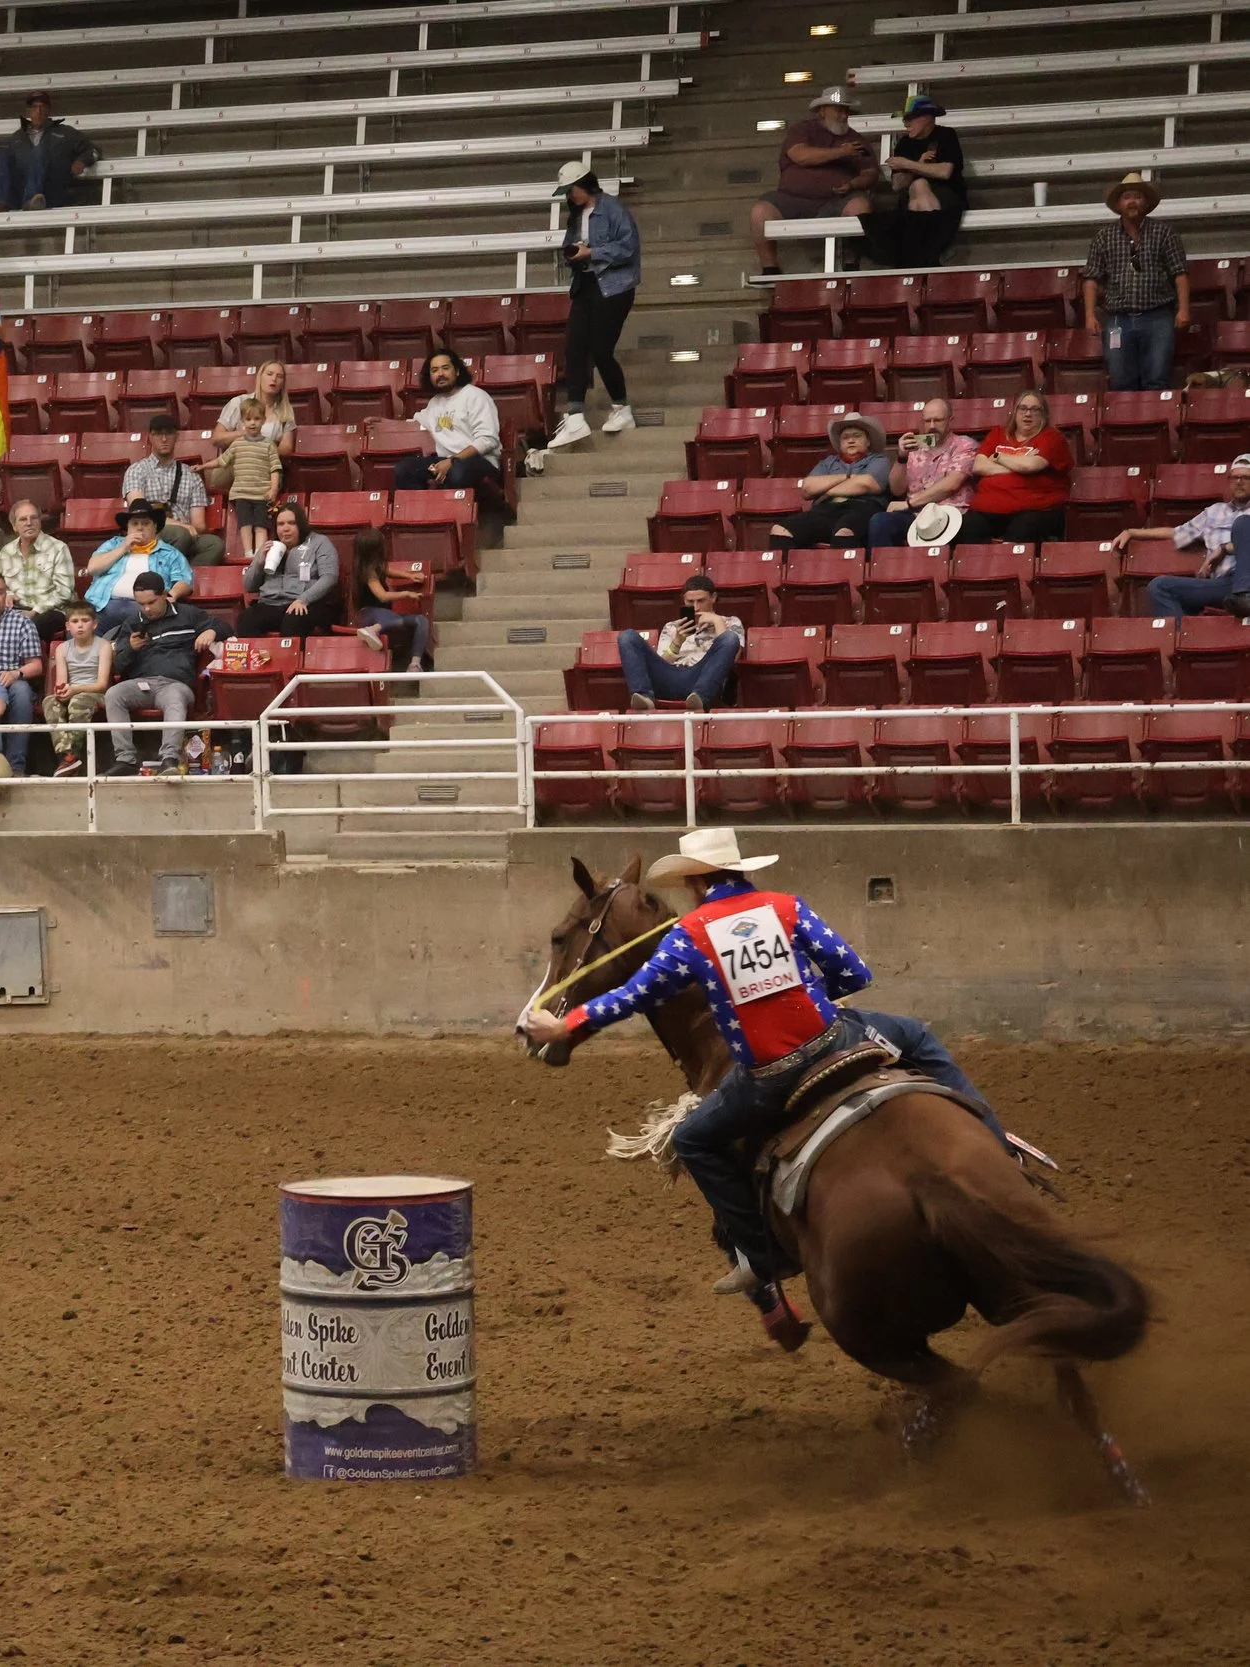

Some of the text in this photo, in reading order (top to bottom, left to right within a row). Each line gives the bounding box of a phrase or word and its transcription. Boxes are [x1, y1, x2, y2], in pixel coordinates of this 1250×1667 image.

[720, 934, 790, 981] 7454
[738, 972, 794, 999] BRISON
[307, 1312, 359, 1352] Spike
[301, 1350, 359, 1382] Center
[425, 1350, 466, 1381] Event
